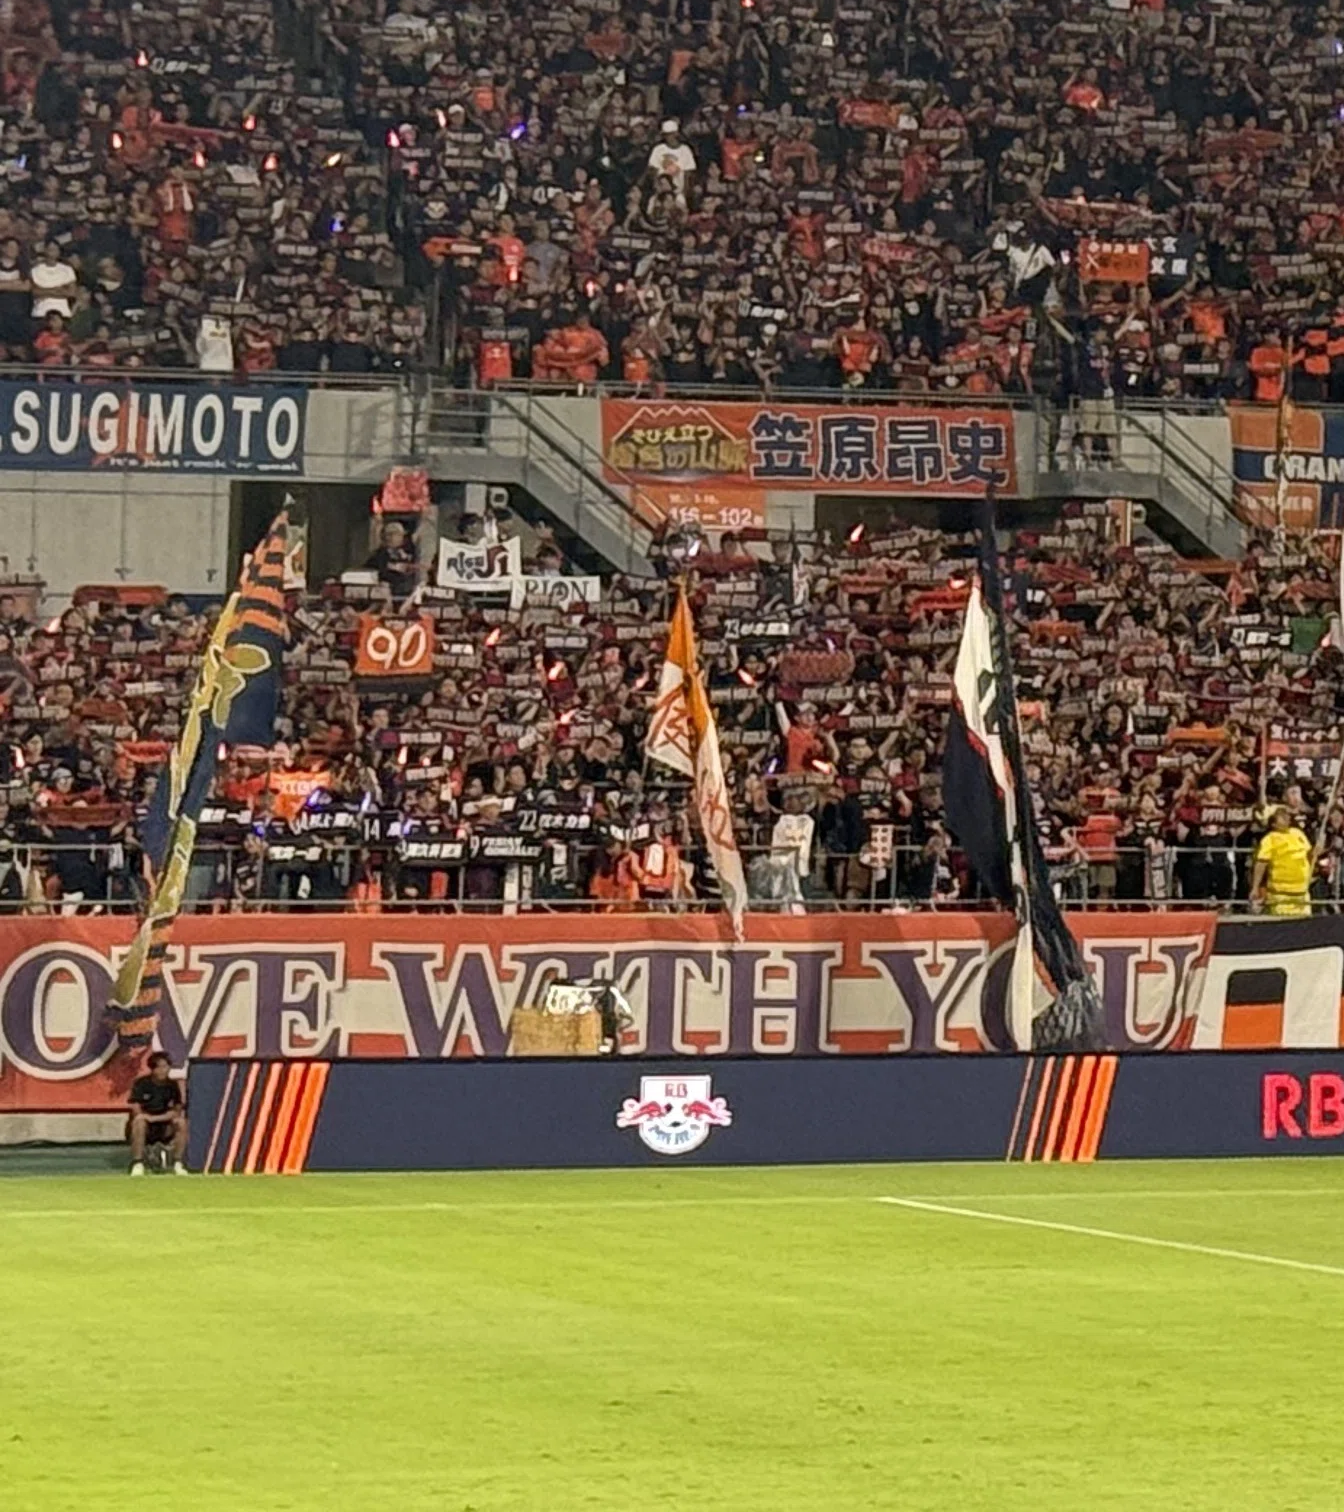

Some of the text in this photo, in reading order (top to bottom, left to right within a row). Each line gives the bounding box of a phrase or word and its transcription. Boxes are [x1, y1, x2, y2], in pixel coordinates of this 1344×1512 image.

[10, 389, 300, 459] SUGIMOTO
[750, 410, 1009, 487] 笠原昂史
[365, 625, 427, 671] 90
[370, 941, 847, 1055] WTH
